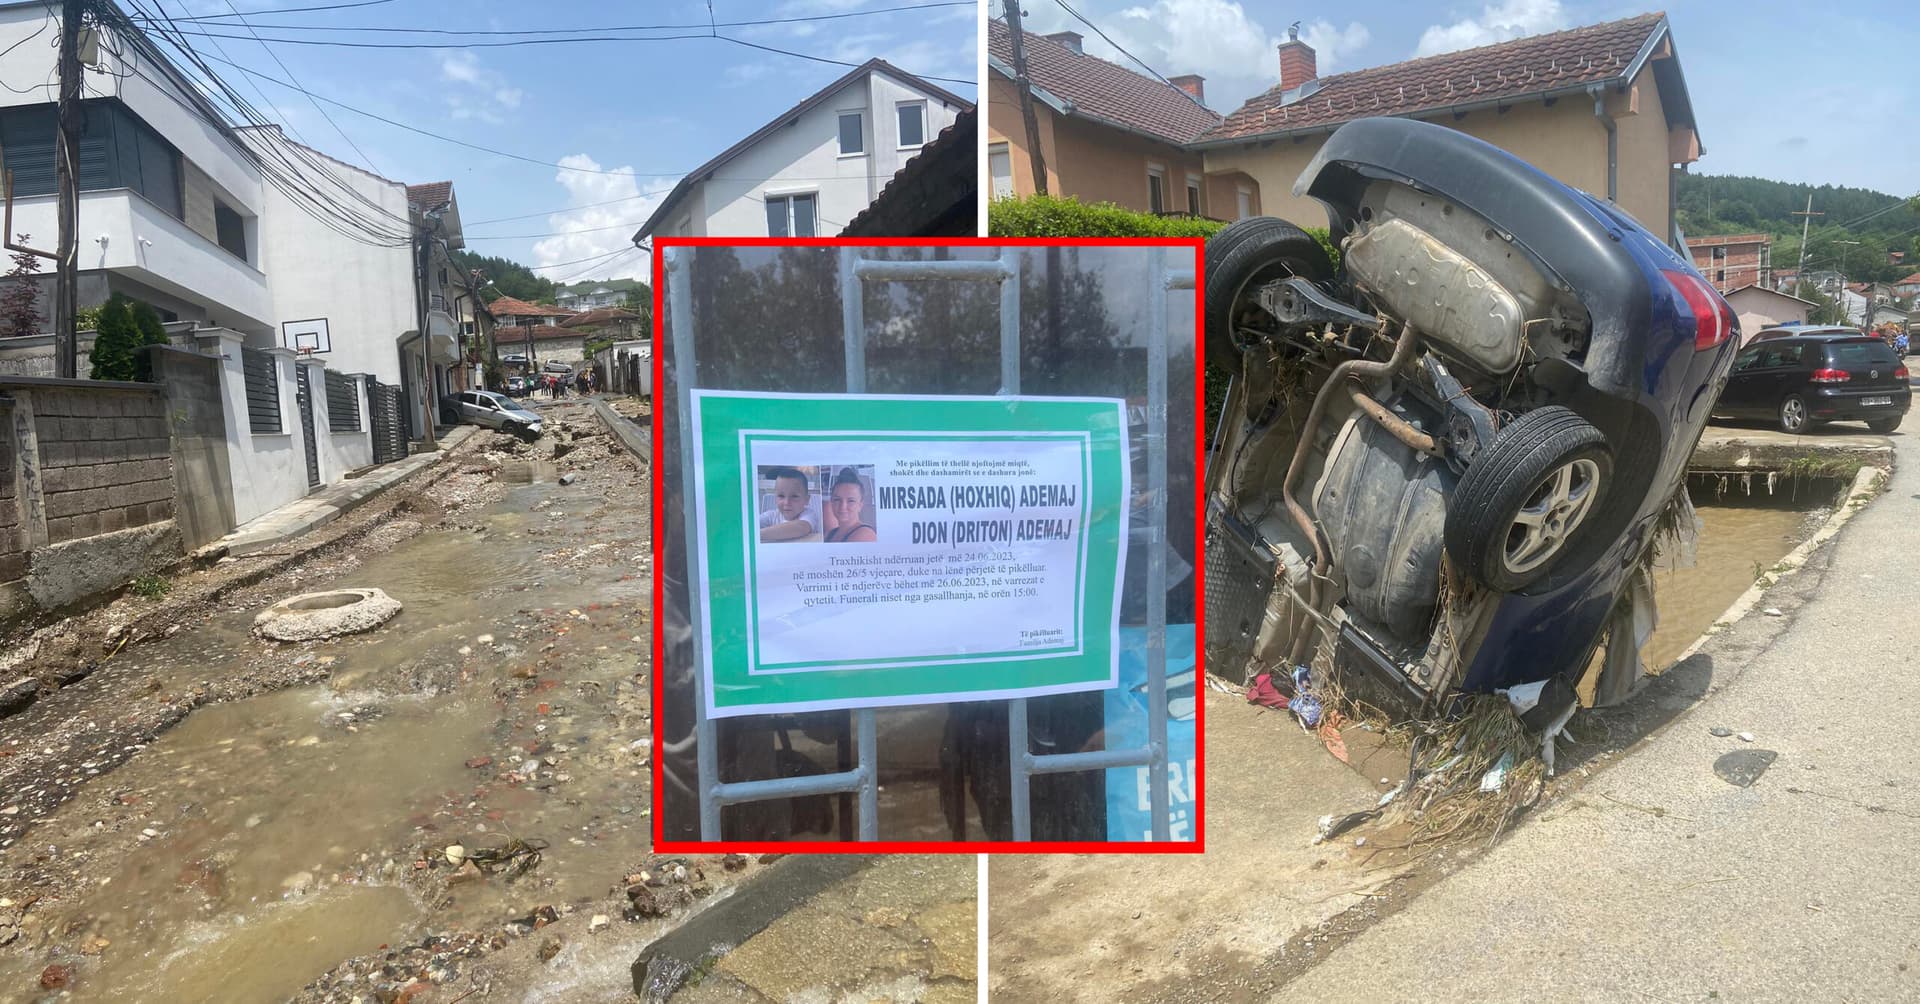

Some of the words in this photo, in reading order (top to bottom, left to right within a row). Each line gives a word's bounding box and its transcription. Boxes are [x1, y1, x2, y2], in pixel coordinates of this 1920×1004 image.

[896, 460, 907, 468] Me
[909, 460, 939, 468] pikëllim
[880, 486, 946, 509] MIRSADA
[950, 485, 1015, 514] (HOXHIQ)
[1019, 484, 1076, 507] ADEMAJ
[912, 522, 947, 544] DION
[952, 520, 1012, 549] (DRITON)
[1016, 519, 1072, 541] ADEMAJ
[830, 556, 882, 566] Traxhikisht
[884, 555, 924, 565] ndërruan
[926, 555, 943, 566] jetë
[948, 554, 962, 562] më
[793, 572, 804, 580] në
[807, 569, 843, 580] moshën
[846, 569, 866, 578] 26/5
[870, 568, 905, 579] vjeçare,
[908, 567, 929, 576] duke
[945, 566, 964, 575] lënë
[966, 565, 995, 576] përjetë
[998, 564, 1006, 573] të
[796, 582, 832, 592] Varrimi
[841, 582, 850, 591] të
[852, 582, 891, 592] ndjerëve
[894, 579, 918, 590] bëhet
[921, 580, 934, 588] më
[937, 577, 989, 588] 26.06.2023,
[992, 578, 1002, 586] në
[1004, 577, 1038, 585] varrezat
[840, 593, 878, 604] Funerali
[880, 593, 902, 602] niset
[905, 594, 921, 603] nga
[978, 590, 989, 598] në
[991, 589, 1011, 598] orën
